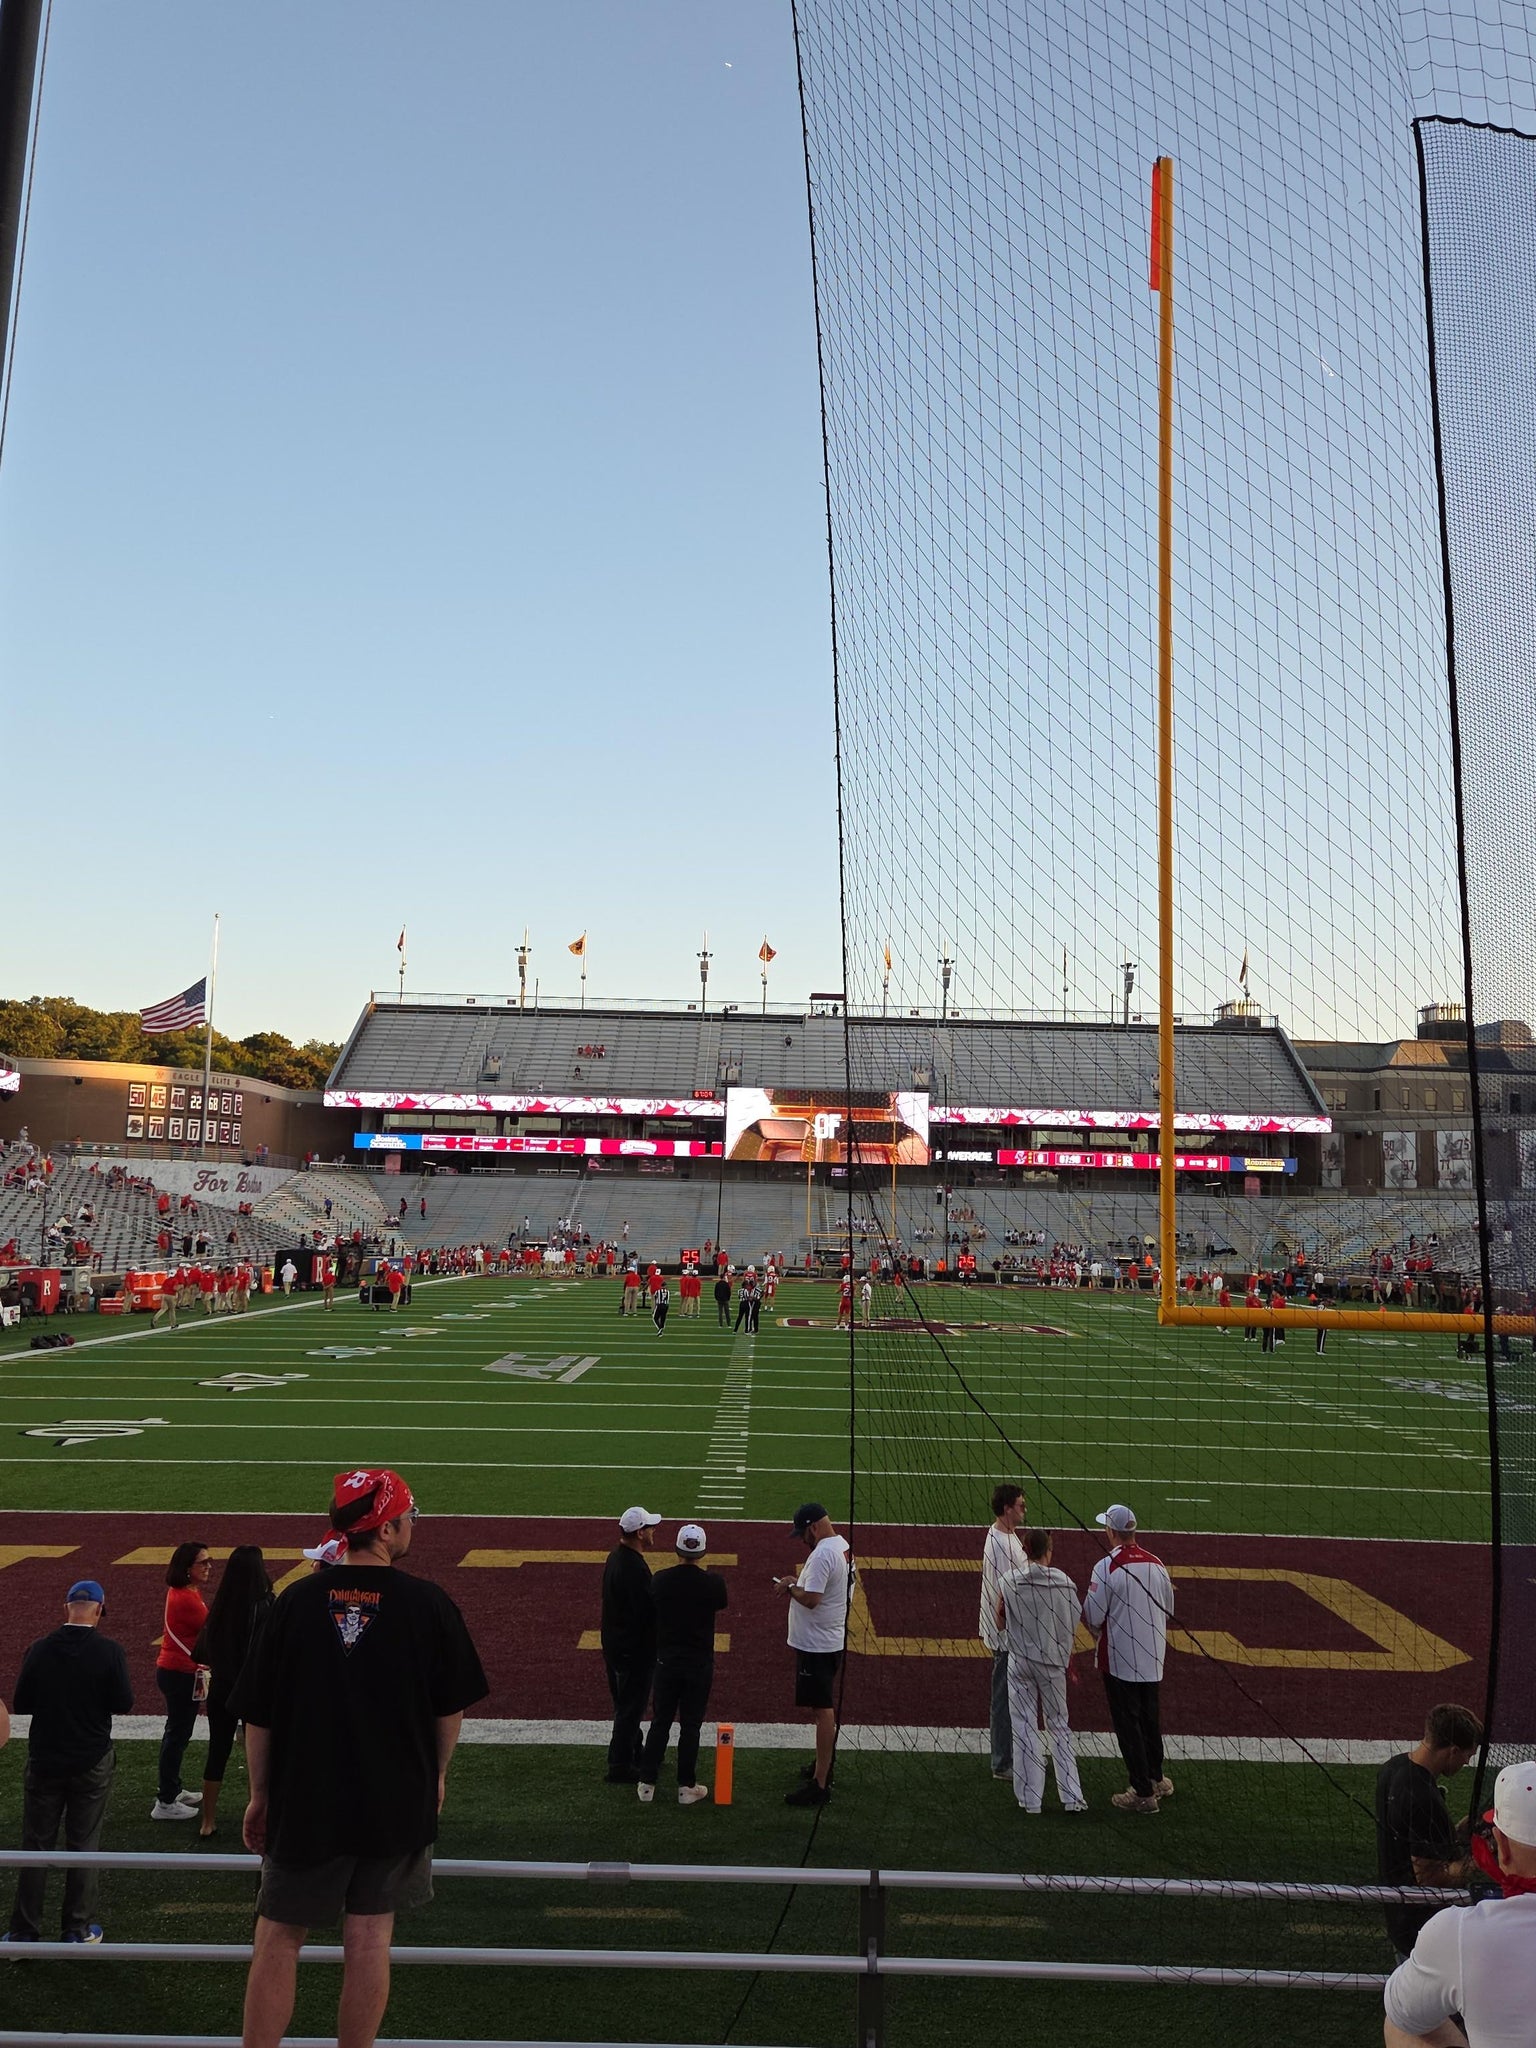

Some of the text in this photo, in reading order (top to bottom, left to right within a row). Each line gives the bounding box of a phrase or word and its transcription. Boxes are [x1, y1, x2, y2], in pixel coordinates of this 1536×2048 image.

[172, 1073, 231, 1086] EAGLE ELITE
[130, 1090, 145, 1105] 50
[190, 1095, 202, 1110] 22
[208, 1096, 219, 1111] 68
[149, 1123, 163, 1137] 70
[189, 1125, 199, 1139] 17
[193, 1169, 229, 1193] For
[682, 1250, 699, 1263] 25
[43, 1279, 51, 1296] R
[132, 1294, 141, 1303] G
